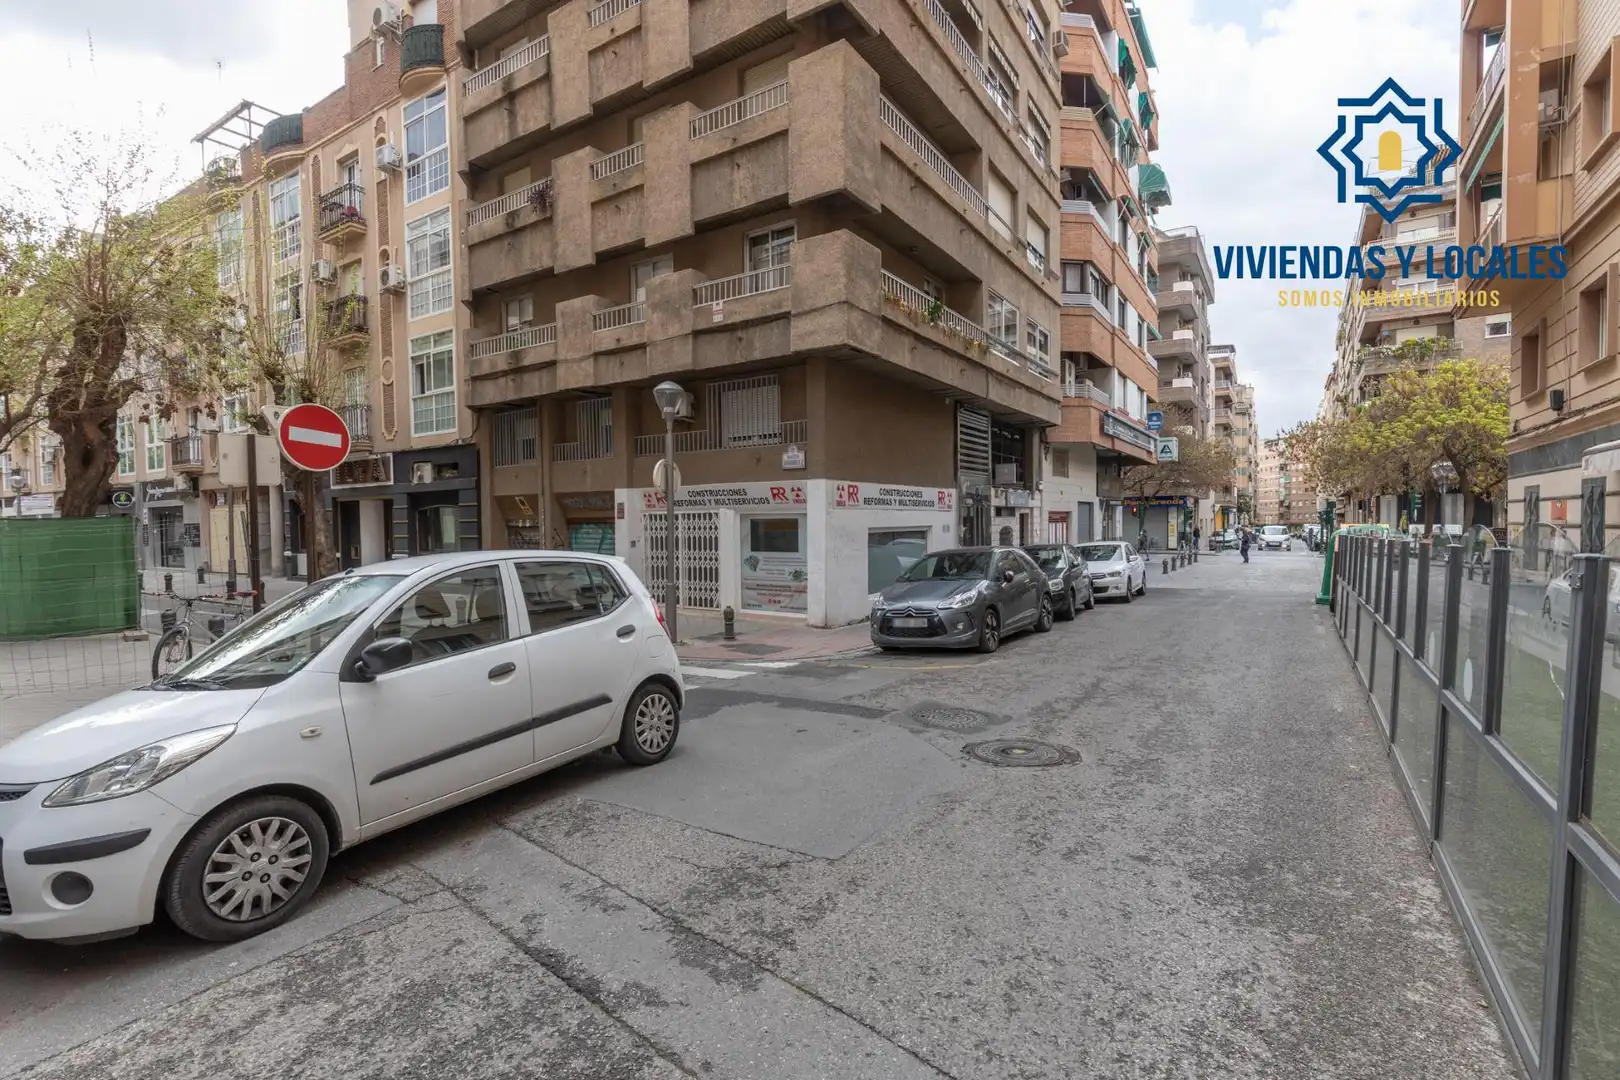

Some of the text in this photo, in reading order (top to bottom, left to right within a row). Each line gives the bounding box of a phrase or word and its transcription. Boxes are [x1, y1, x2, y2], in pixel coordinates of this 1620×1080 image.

[687, 488, 748, 498] CONSTRUCCIONES
[879, 488, 923, 498] CONSTRUCCIONES
[673, 497, 770, 507] REFORMAS Y MULTISERVICIOS
[863, 497, 935, 508] REFORMAS Y MULTISERVICIOS
